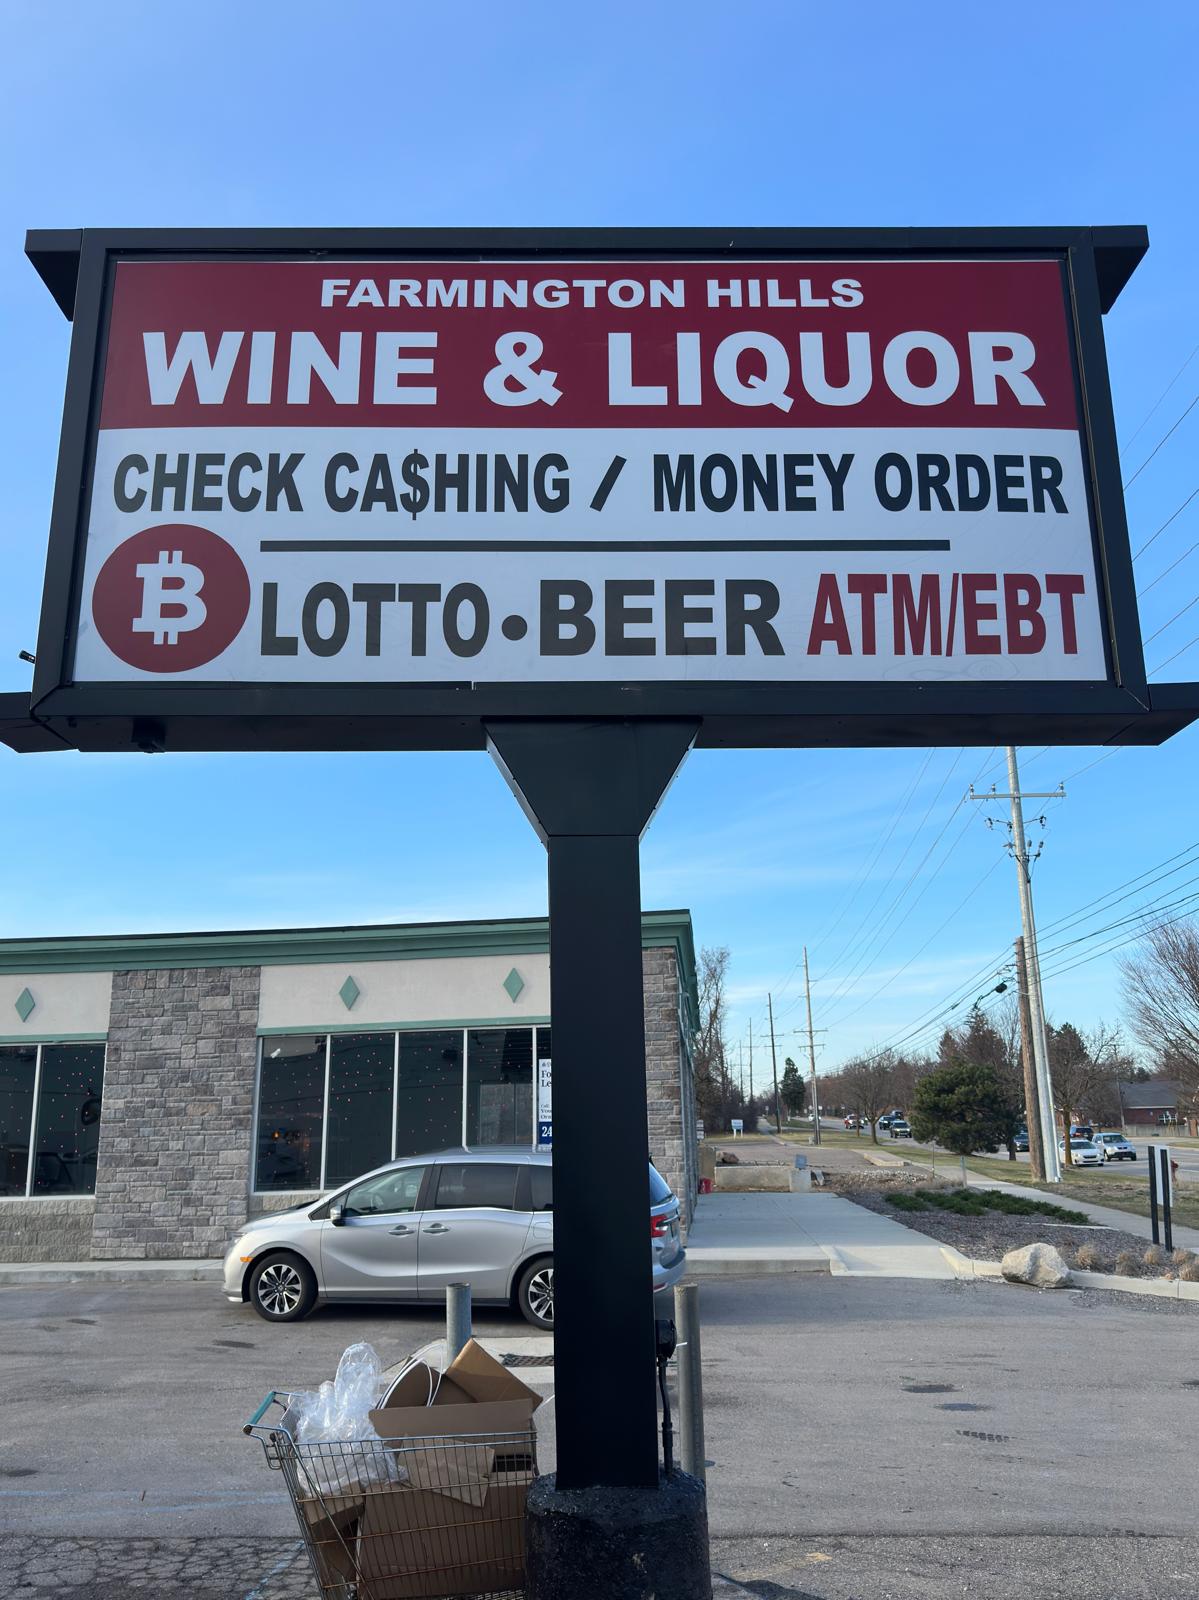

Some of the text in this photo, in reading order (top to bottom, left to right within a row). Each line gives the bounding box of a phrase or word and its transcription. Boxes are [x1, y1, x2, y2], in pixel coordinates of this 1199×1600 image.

[321, 279, 864, 308] FARMINGTON HILLS
[142, 330, 1046, 413] WINE & LIQUOR
[114, 448, 1070, 521] CHECK CA$HING / MONEY ORDER
[806, 572, 1086, 658] ATM/EBT
